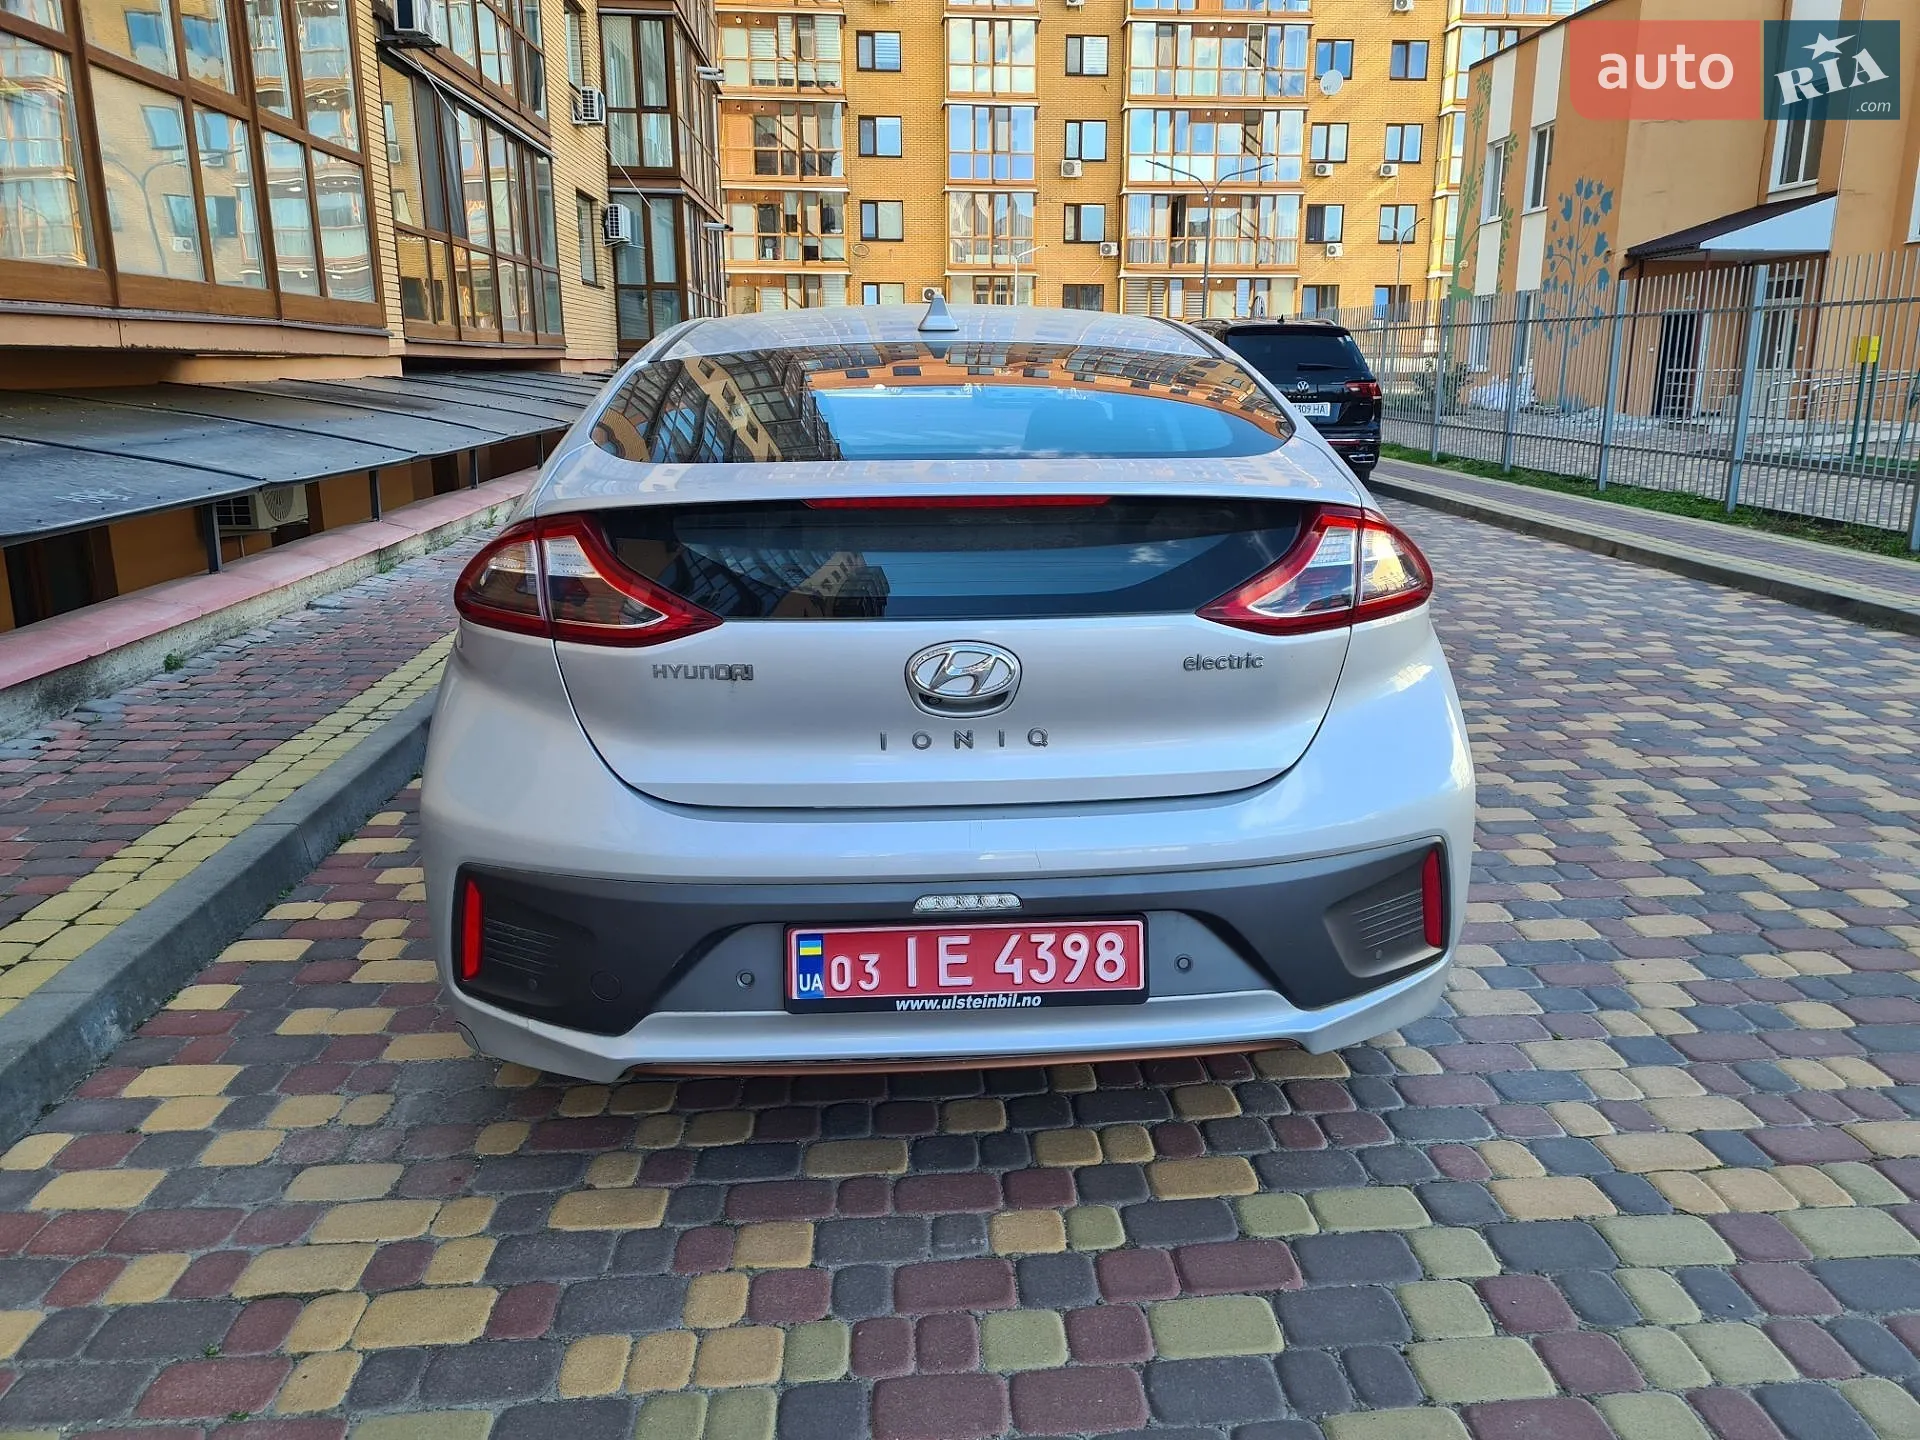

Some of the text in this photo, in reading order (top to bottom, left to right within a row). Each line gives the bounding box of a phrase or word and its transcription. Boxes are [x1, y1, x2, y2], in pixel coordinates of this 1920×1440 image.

[1313, 404, 1325, 414] HA
[1183, 651, 1265, 672] electric
[652, 663, 754, 682] HYUNDAI
[879, 726, 1049, 751] IONIQ
[799, 931, 1128, 992] UA 03 IE 4398
[895, 993, 1042, 1012] www.ulsteinbil.no
